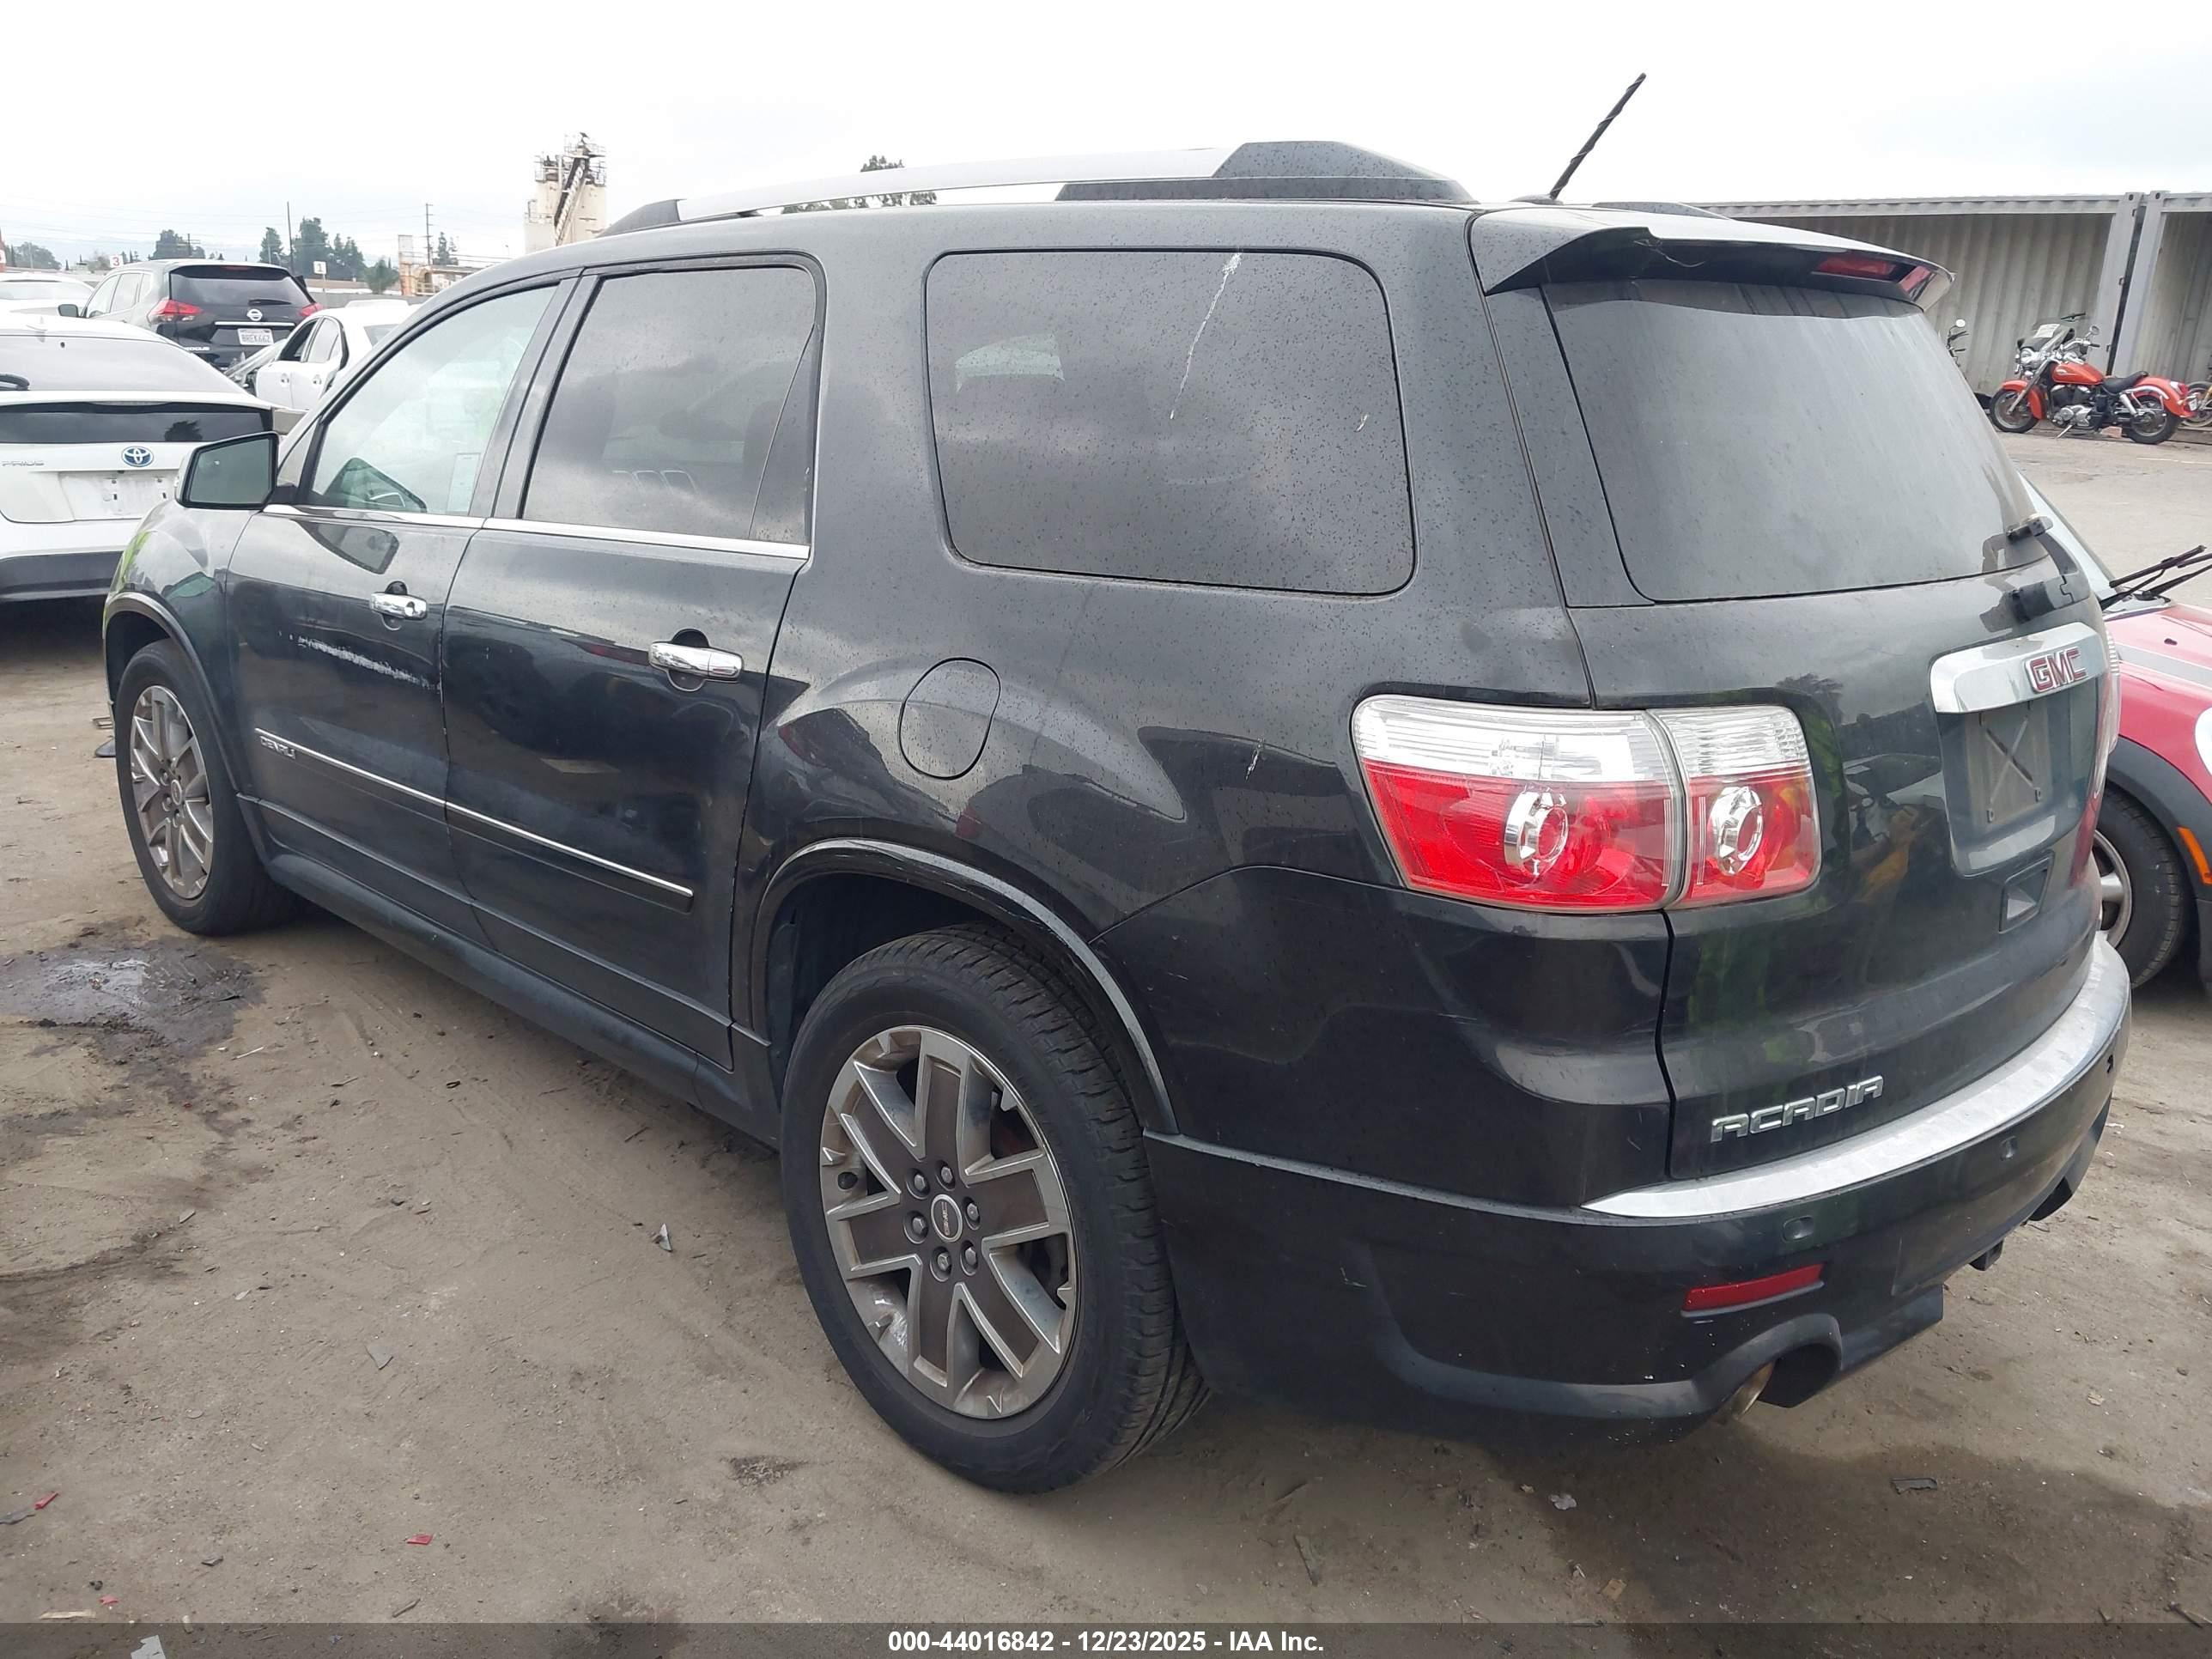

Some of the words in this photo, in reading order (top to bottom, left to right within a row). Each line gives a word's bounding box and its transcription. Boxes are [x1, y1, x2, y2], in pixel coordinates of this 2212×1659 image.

[113, 256, 120, 266] 3
[2026, 646, 2088, 693] GMC
[1711, 1075, 1884, 1143] ACADIA
